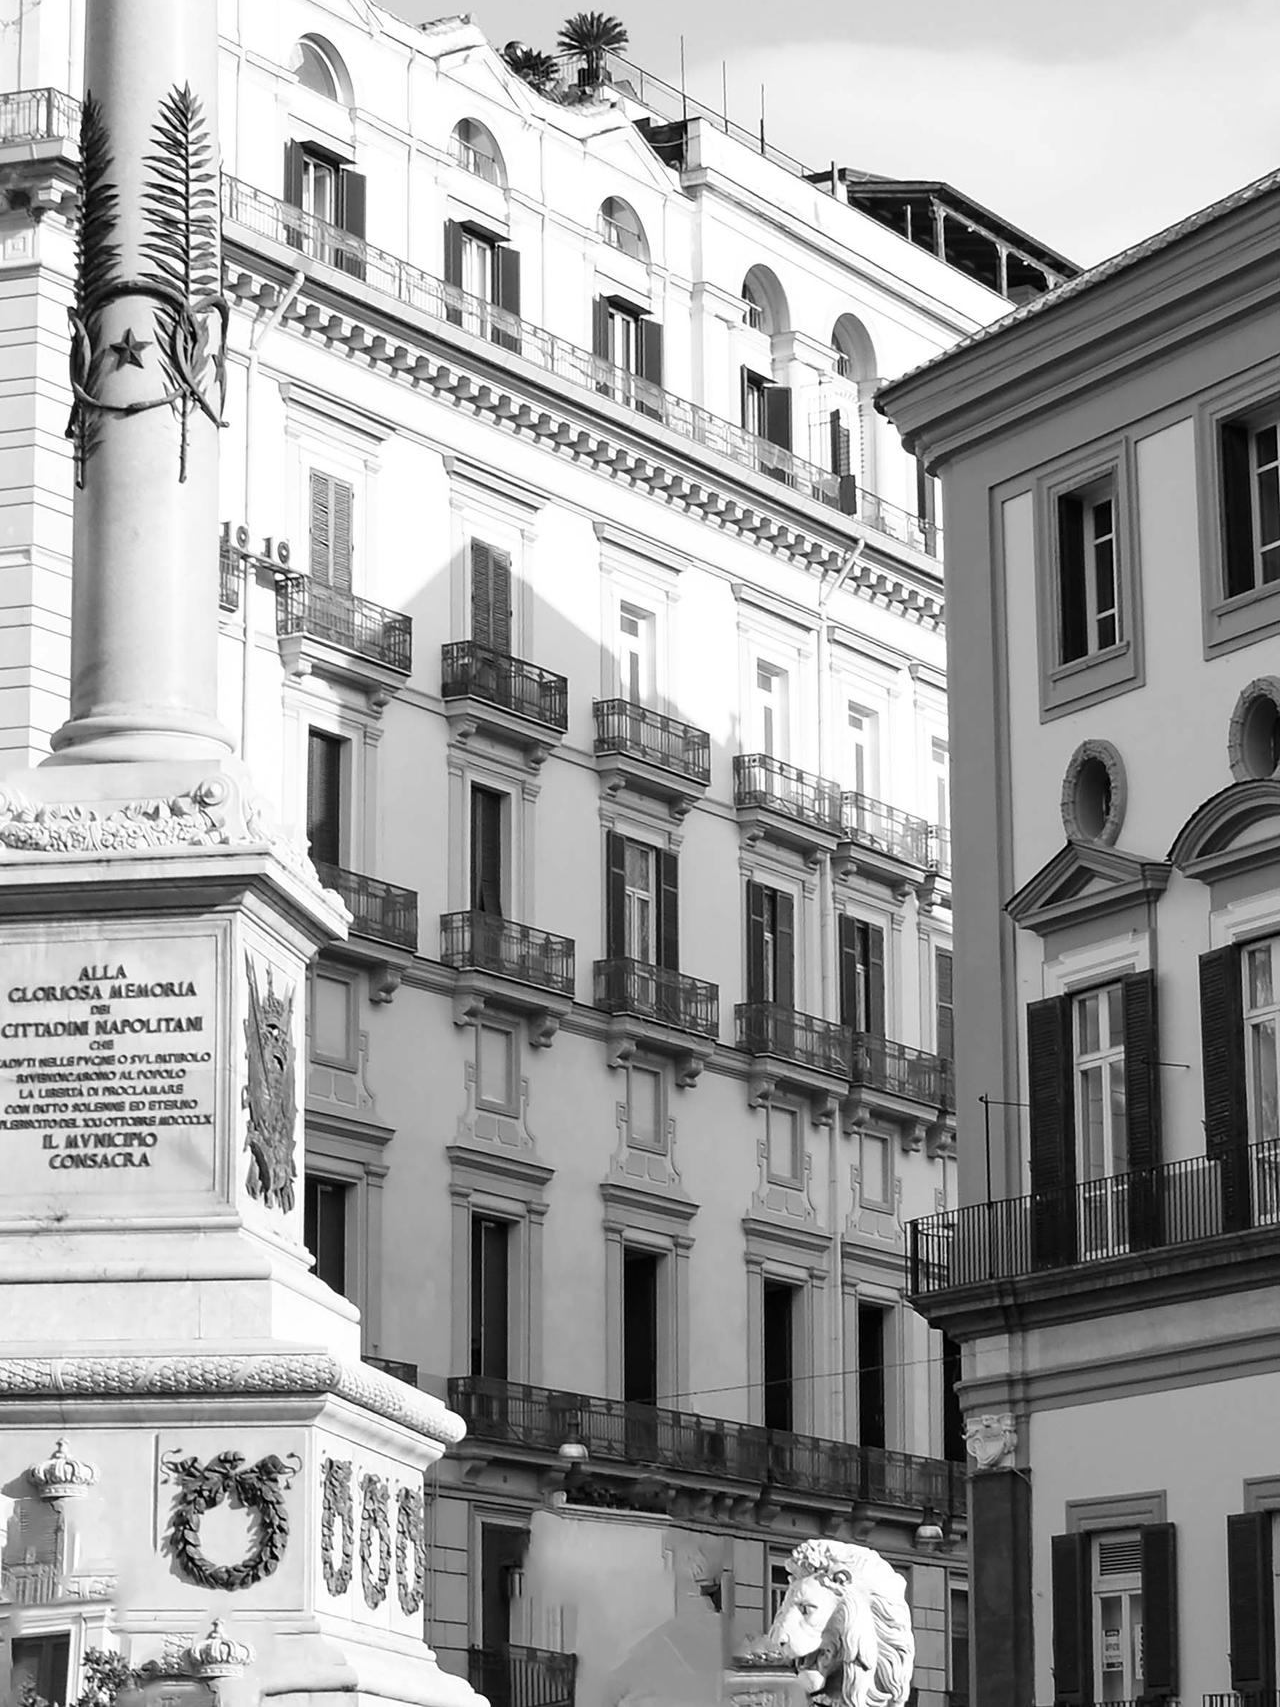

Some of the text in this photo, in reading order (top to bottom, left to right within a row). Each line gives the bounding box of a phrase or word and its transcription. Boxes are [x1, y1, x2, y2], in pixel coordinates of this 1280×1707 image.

[78, 965, 127, 982] ALLA
[7, 981, 197, 1003] GLORIOSA MEMORIA
[90, 1004, 111, 1015] DEI
[0, 1015, 203, 1038] CITTADINI NAPOLITANI
[88, 1039, 114, 1051] CHE
[38, 1055, 75, 1068] NELLE
[117, 1054, 128, 1065] O
[155, 1051, 212, 1064] PATIBOLO
[15, 1068, 187, 1084] RIVENDICARONO AL POPOLO
[19, 1082, 184, 1100] LA LIBERTÀ DI PROCLAMARE
[4, 1098, 198, 1115] CON PATTO SOLENNE ED ETERNO
[59, 1117, 82, 1129] DEL
[81, 1117, 103, 1129] XXI
[103, 1115, 157, 1128] OTTOBRE
[41, 1133, 60, 1150] IL
[47, 1151, 151, 1170] CONSACRA
